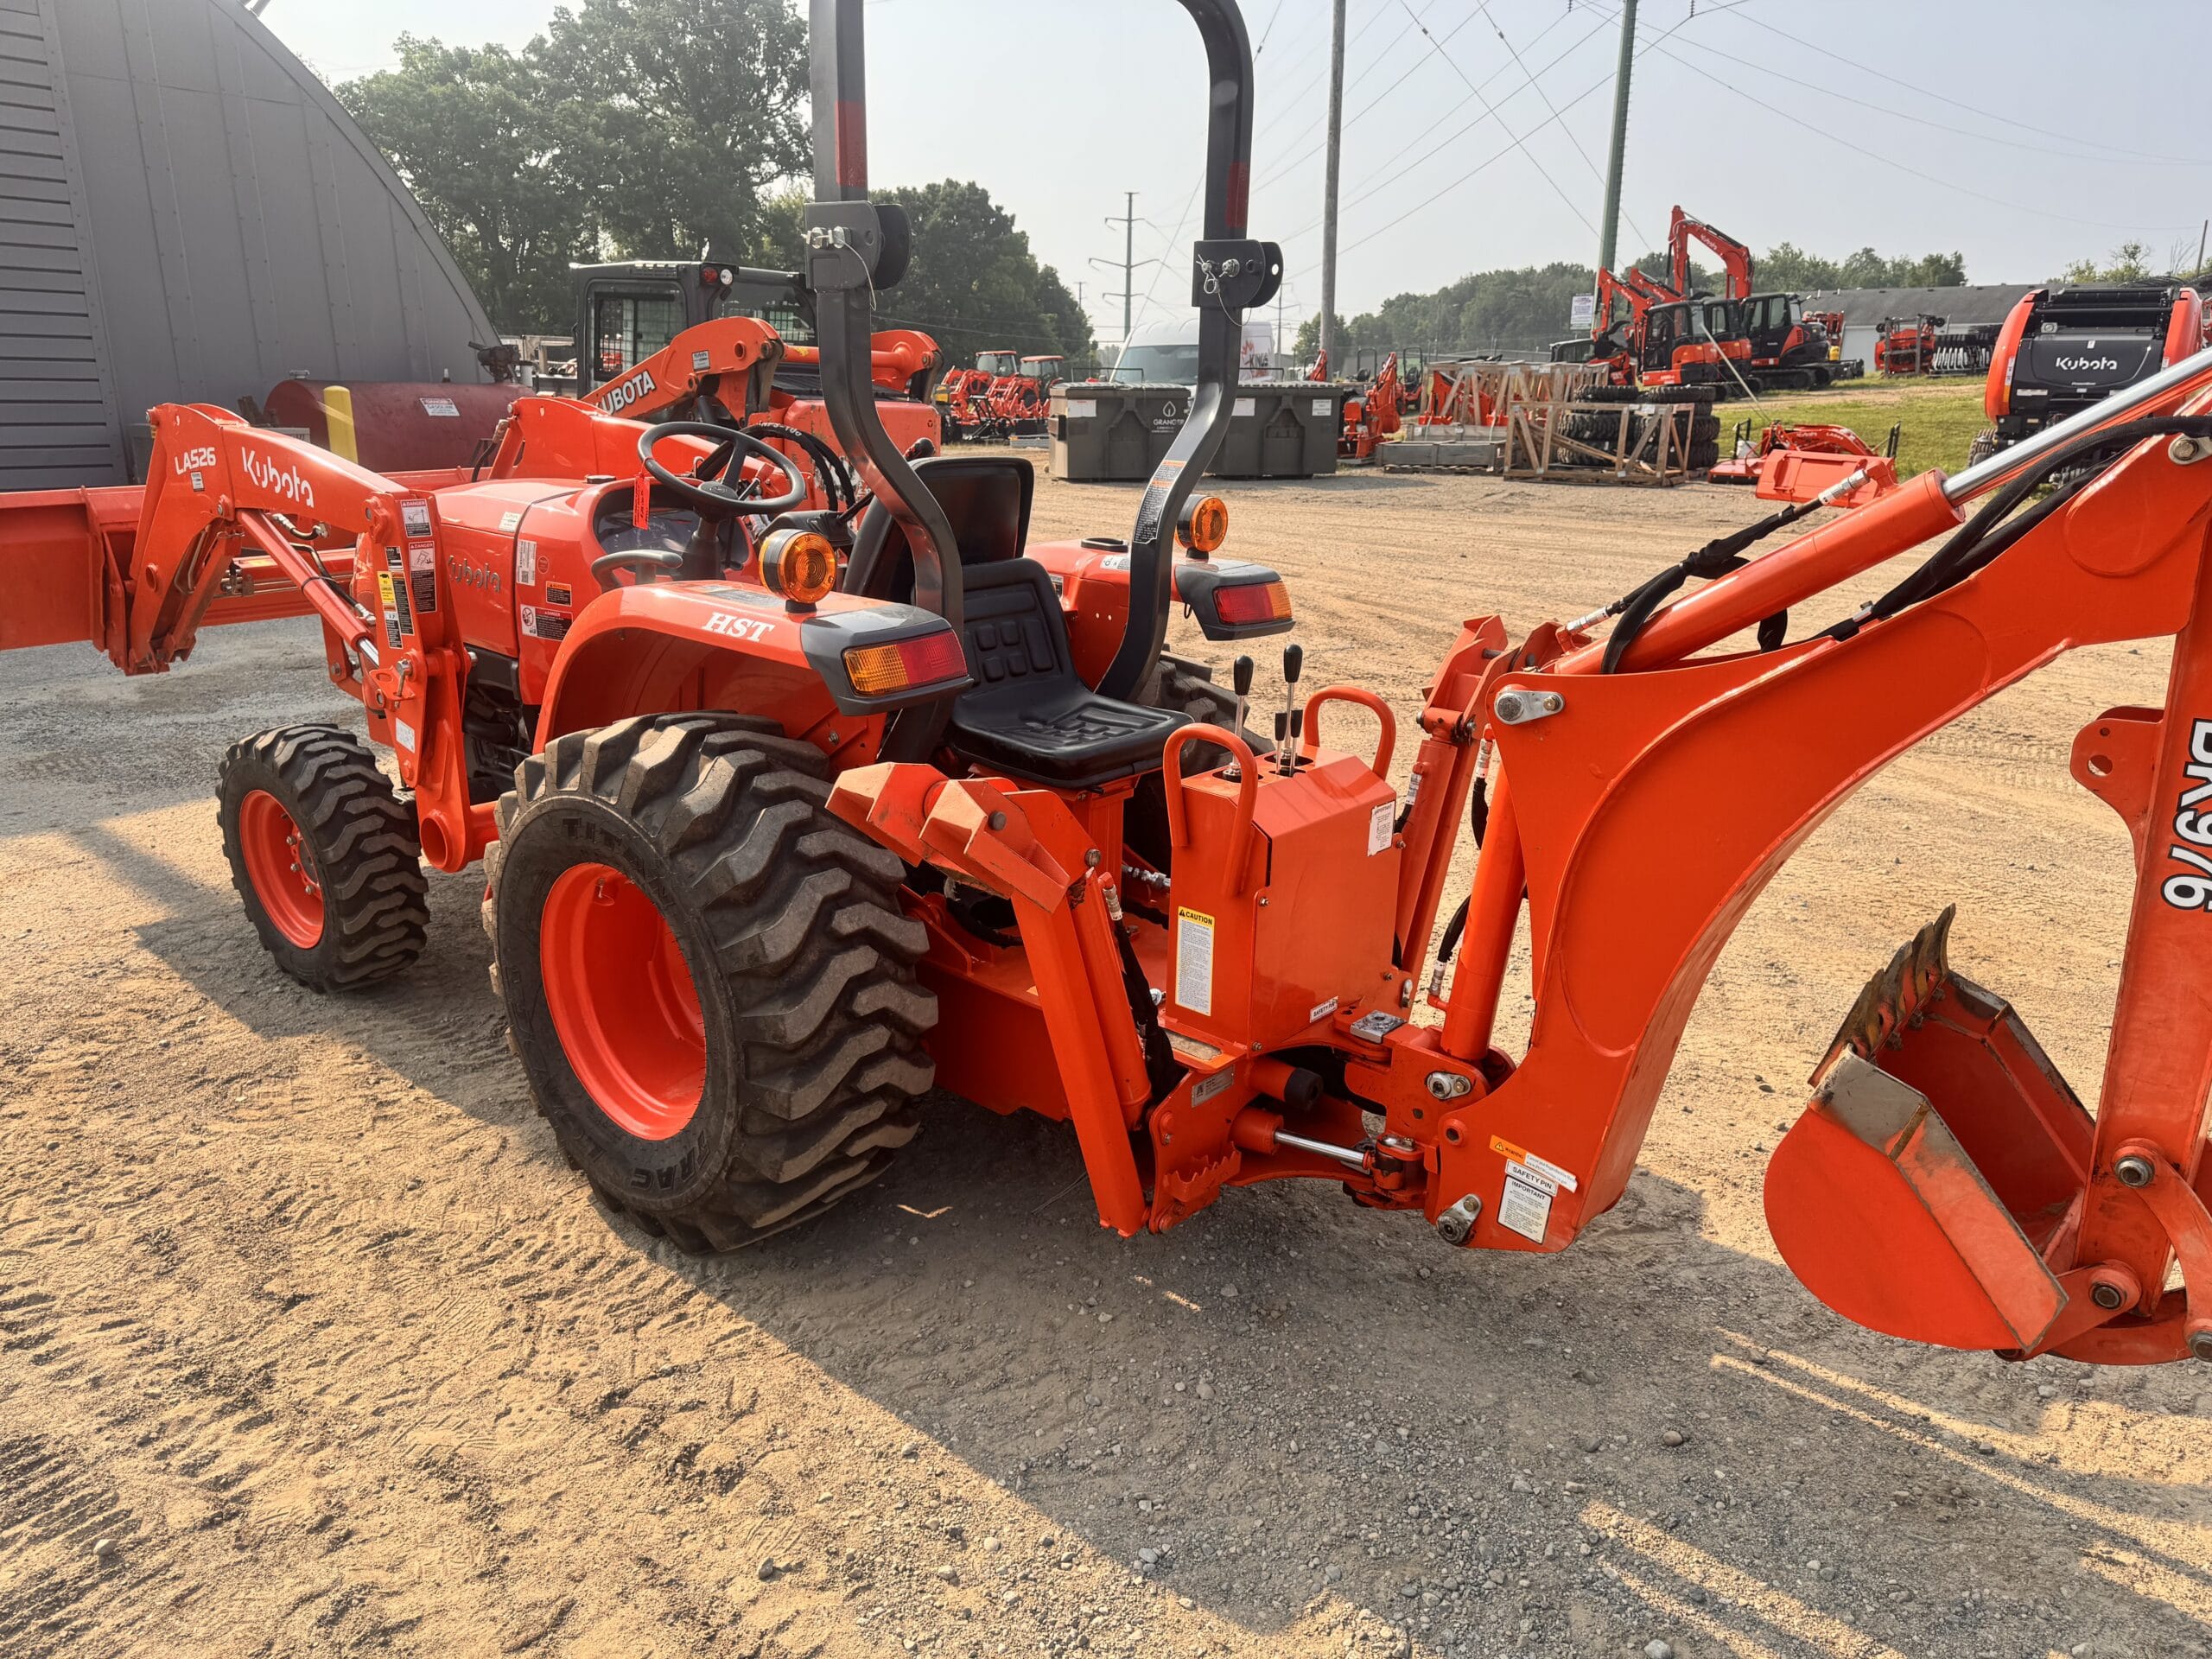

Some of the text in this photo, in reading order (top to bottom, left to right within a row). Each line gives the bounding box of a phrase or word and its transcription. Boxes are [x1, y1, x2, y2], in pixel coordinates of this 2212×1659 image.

[2056, 357, 2117, 370] Kubota
[597, 372, 656, 415] UBOTA
[175, 447, 216, 475] LA526
[242, 446, 315, 508] Kubota
[701, 612, 776, 643] HST
[1185, 911, 1213, 925] CAUTION
[1511, 1180, 1546, 1200] IMPORTANT
[1513, 1166, 1553, 1190] SAFETY PIN
